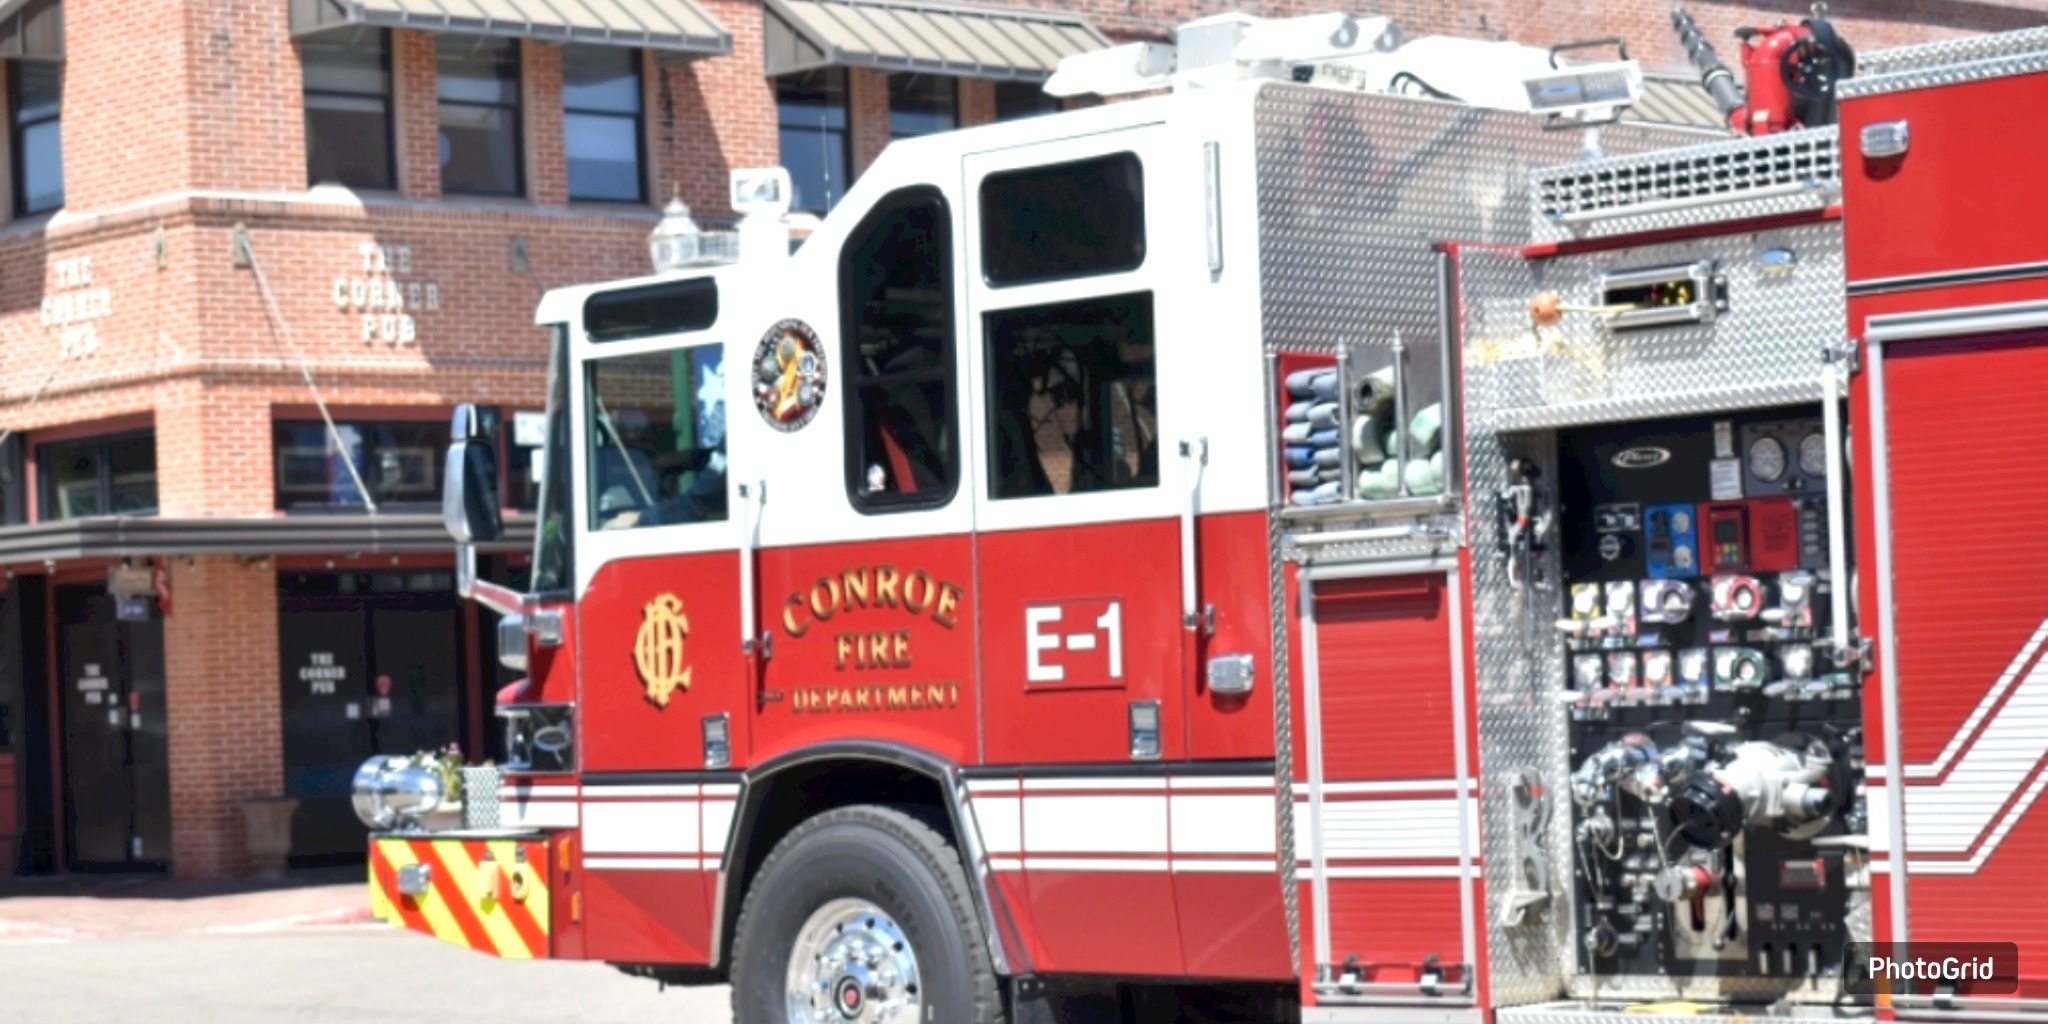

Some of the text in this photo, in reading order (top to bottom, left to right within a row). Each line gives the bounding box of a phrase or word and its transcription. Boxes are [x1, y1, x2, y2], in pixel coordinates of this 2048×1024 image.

[55, 256, 91, 286] THE
[360, 242, 411, 272] THE
[334, 279, 439, 310] CORNER
[362, 313, 416, 343] PUB
[782, 565, 965, 640] CONROE
[835, 628, 913, 672] FIRE
[1026, 601, 1122, 682] E-1
[791, 681, 961, 715] DEPARTMENT
